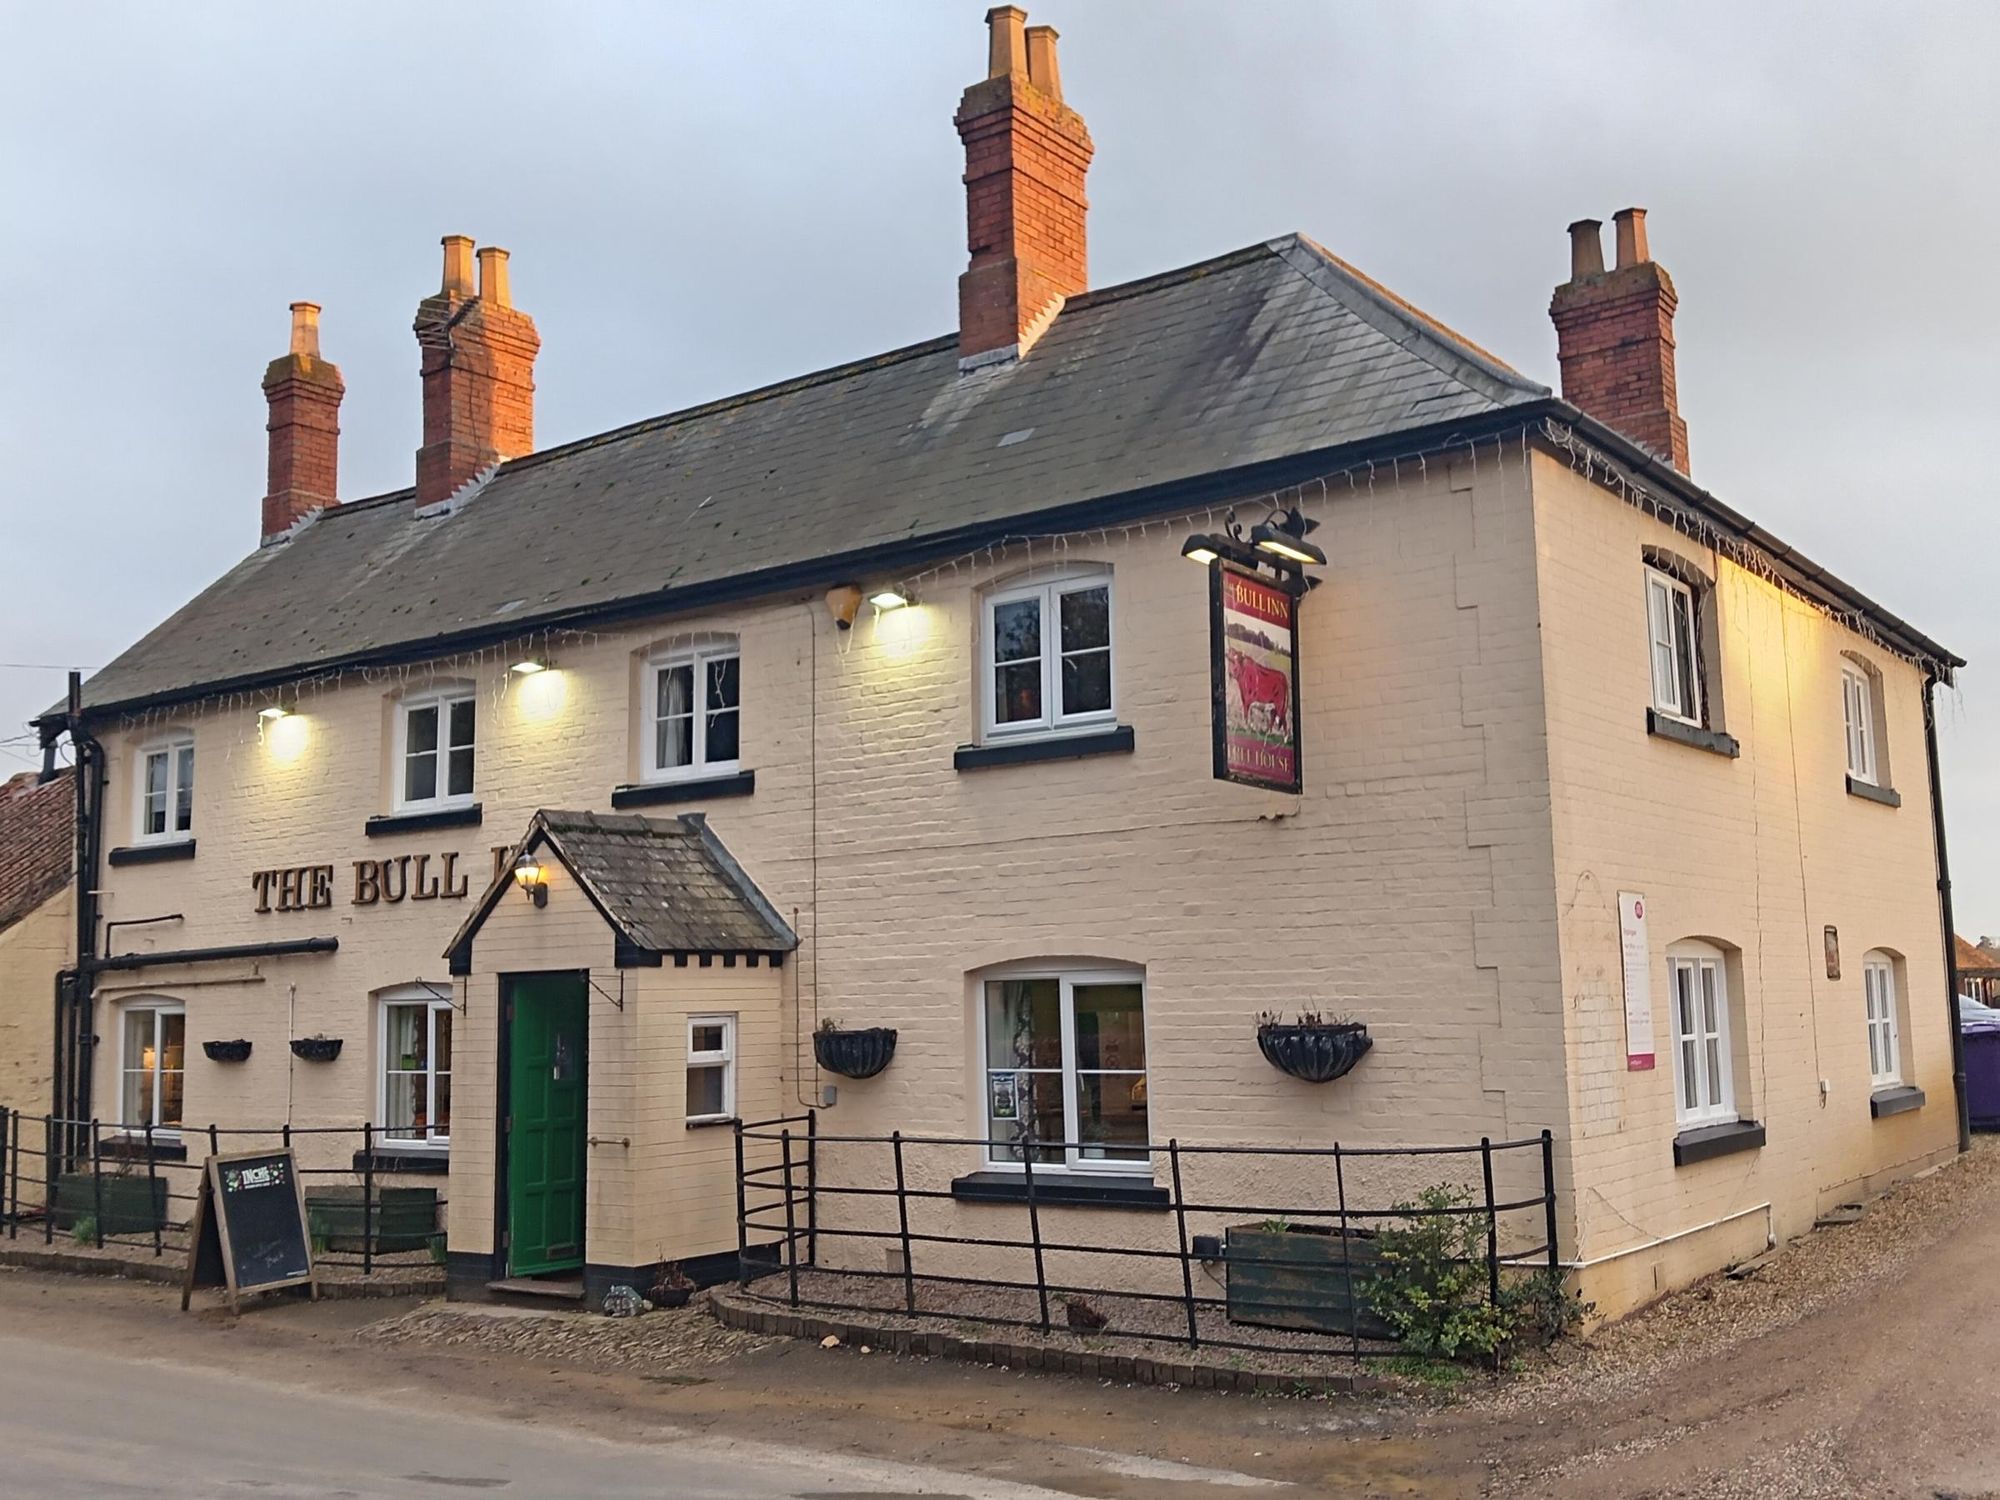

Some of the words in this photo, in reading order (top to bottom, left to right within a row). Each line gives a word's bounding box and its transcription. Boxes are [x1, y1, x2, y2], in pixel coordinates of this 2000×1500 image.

[1236, 583, 1266, 612] BULL
[1267, 596, 1289, 619] INN
[252, 864, 334, 913] THE
[351, 852, 469, 906] BULL
